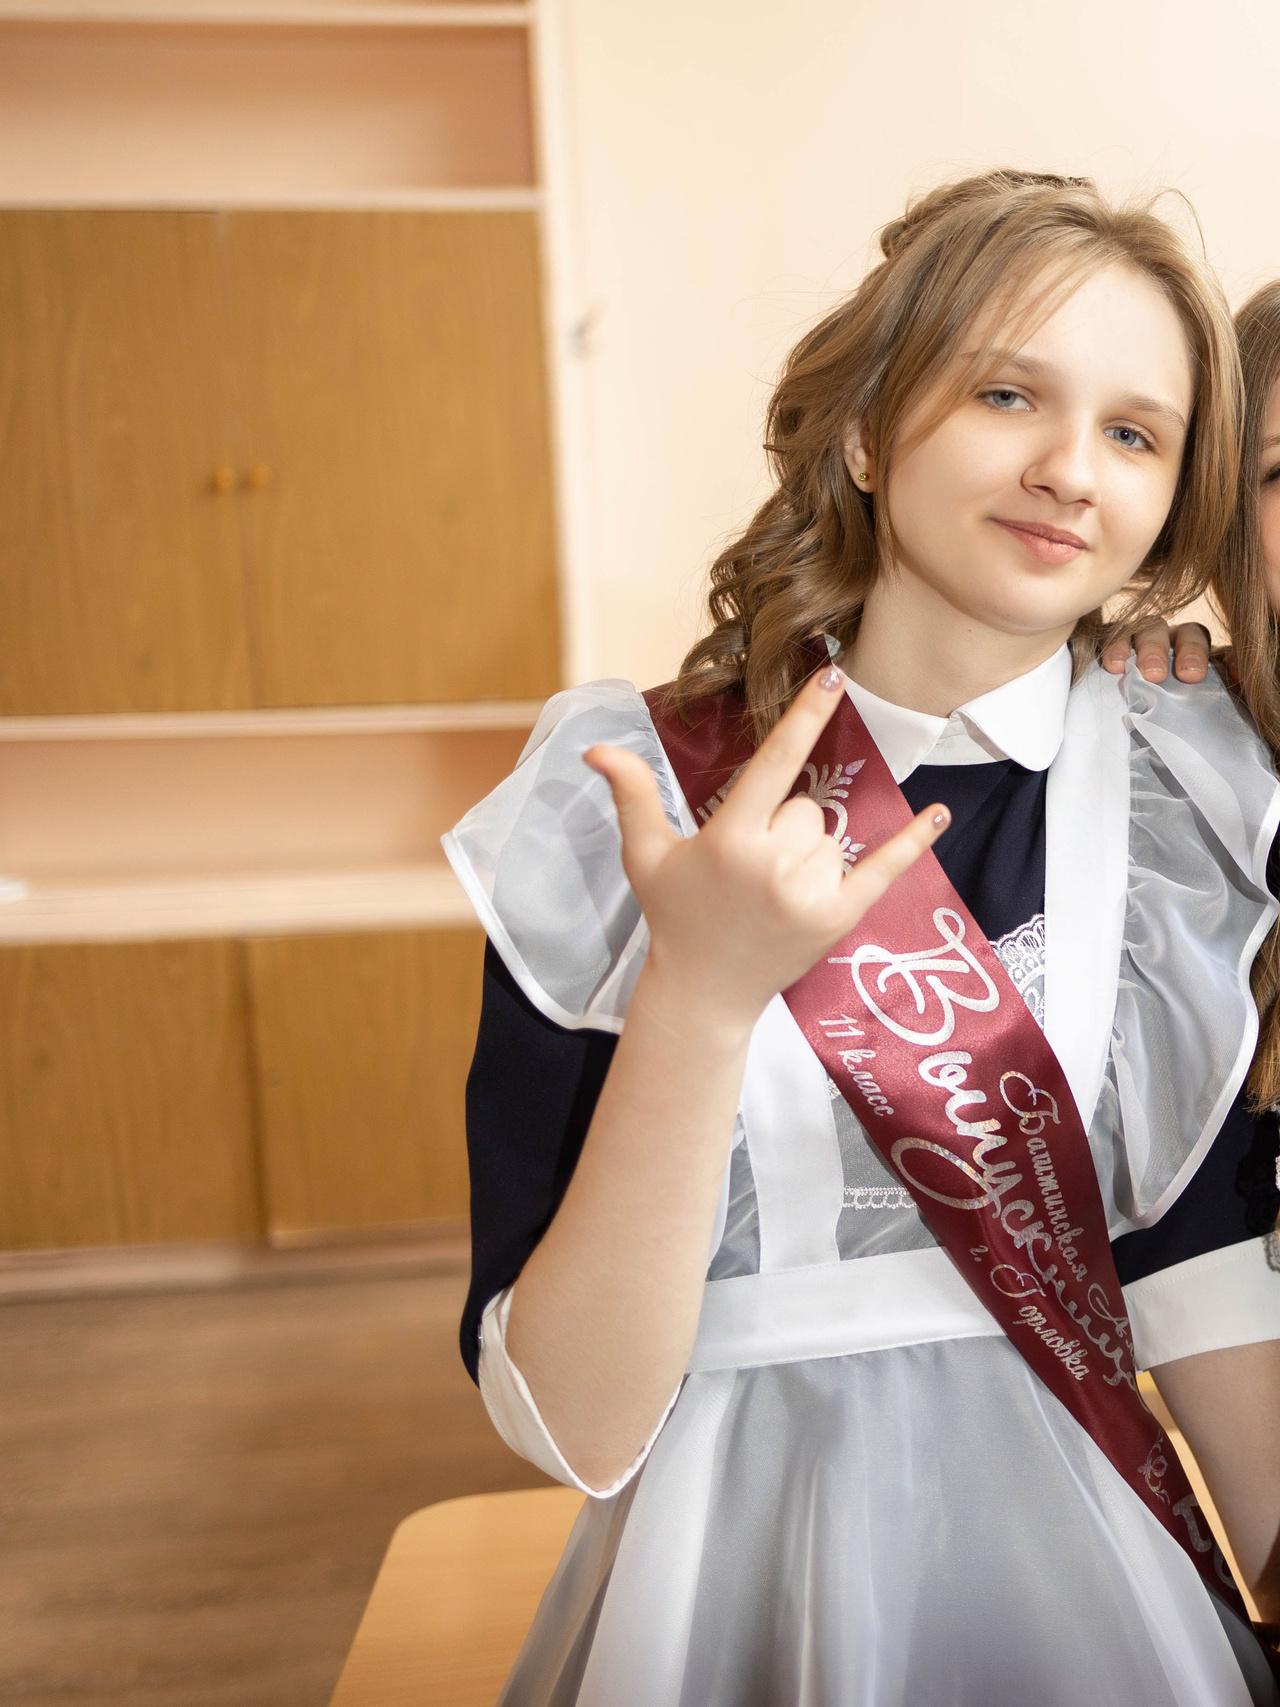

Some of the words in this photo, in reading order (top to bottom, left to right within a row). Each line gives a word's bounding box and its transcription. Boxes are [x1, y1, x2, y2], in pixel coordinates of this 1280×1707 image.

[819, 1014, 865, 1038] 11
[838, 1049, 894, 1116] класс
[969, 1245, 988, 1262] г.
[990, 1264, 1090, 1381] Горловка
